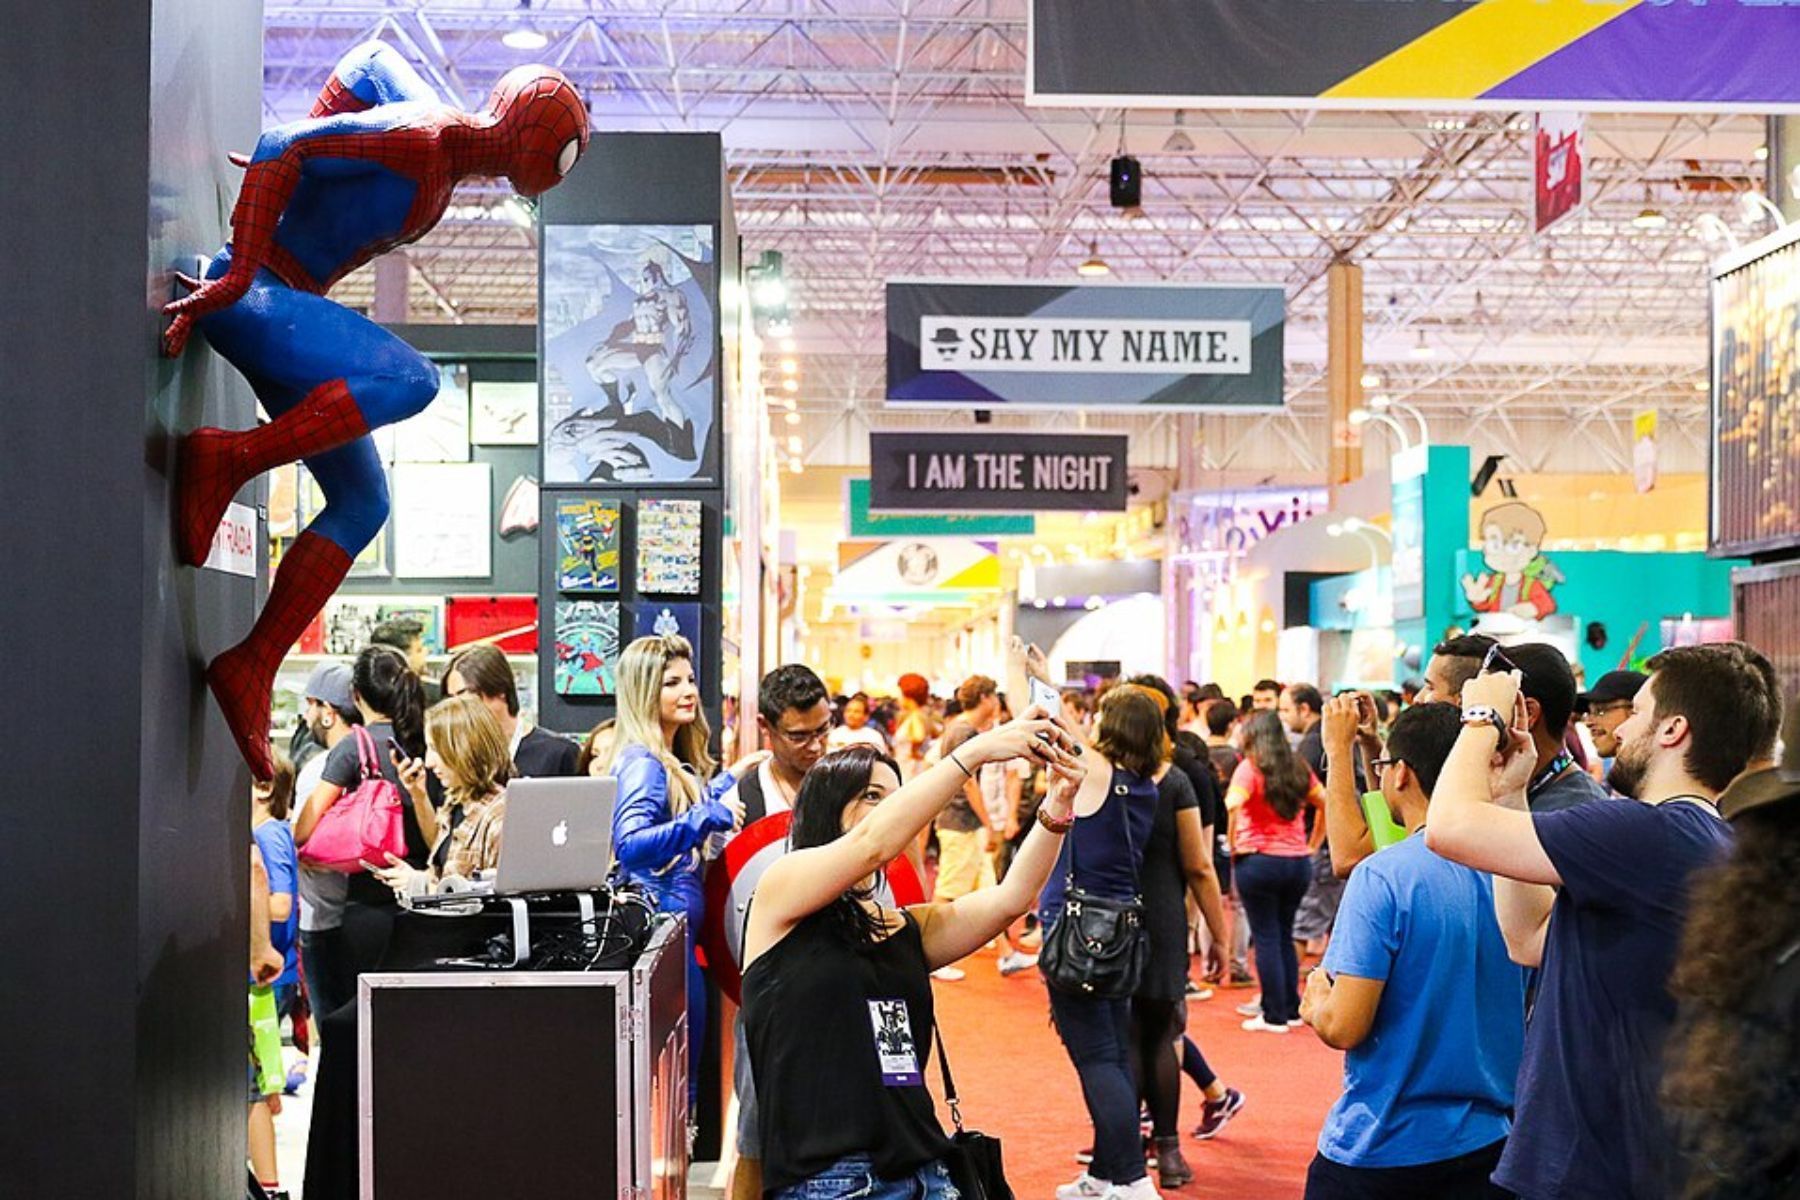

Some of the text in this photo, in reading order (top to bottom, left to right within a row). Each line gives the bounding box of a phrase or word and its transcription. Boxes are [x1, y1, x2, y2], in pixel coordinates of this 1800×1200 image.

[970, 327, 1239, 363] SAY MY NAME.
[908, 453, 1113, 491] I AM THE NIGHT
